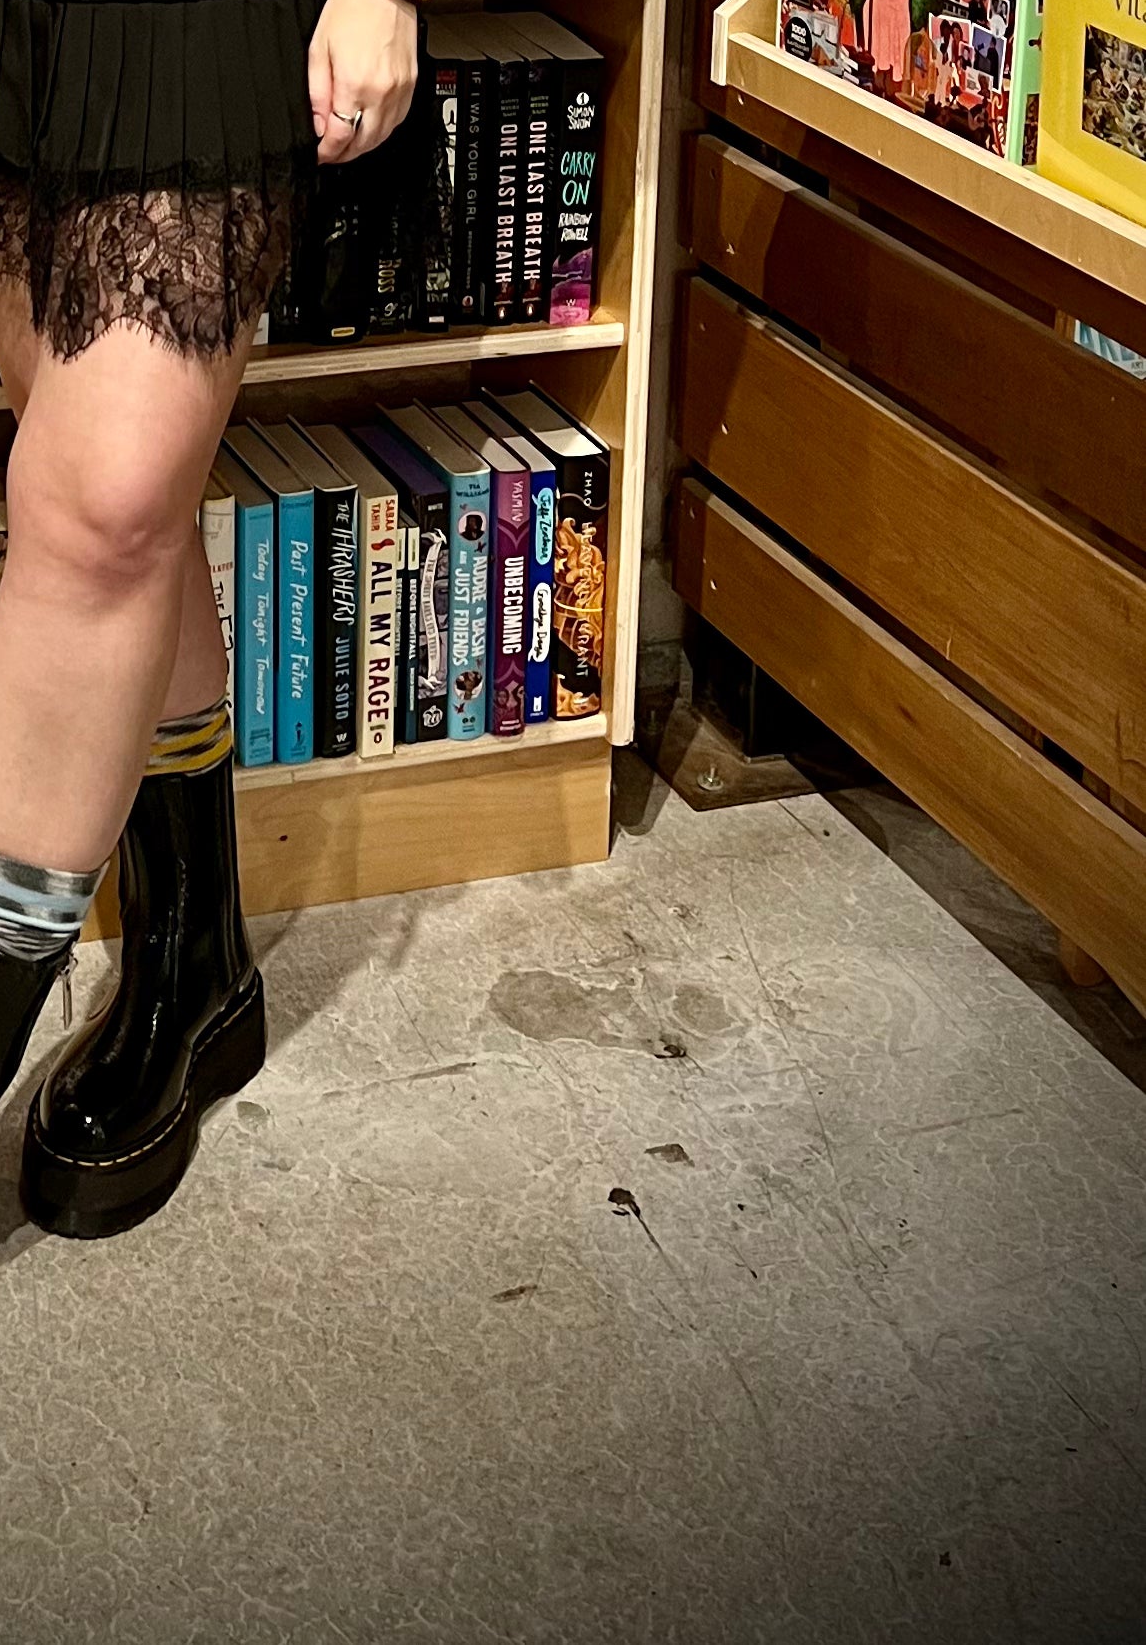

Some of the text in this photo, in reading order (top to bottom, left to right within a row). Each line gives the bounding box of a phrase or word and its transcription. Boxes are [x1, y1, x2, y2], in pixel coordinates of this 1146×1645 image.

[500, 125, 517, 161] ONE
[529, 121, 546, 162] ONE
[568, 117, 591, 129] SNOW
[527, 162, 544, 204] LAST
[561, 152, 596, 177] CARRY
[498, 165, 515, 206] LAST
[562, 180, 590, 205] ON
[558, 213, 592, 228] RAINBOW
[561, 228, 587, 241] ROWELL
[496, 215, 514, 283] BREATH
[524, 212, 542, 280] BREATH
[502, 556, 524, 655] UNBECOMING
[368, 561, 393, 723] ALL MY RAGE
